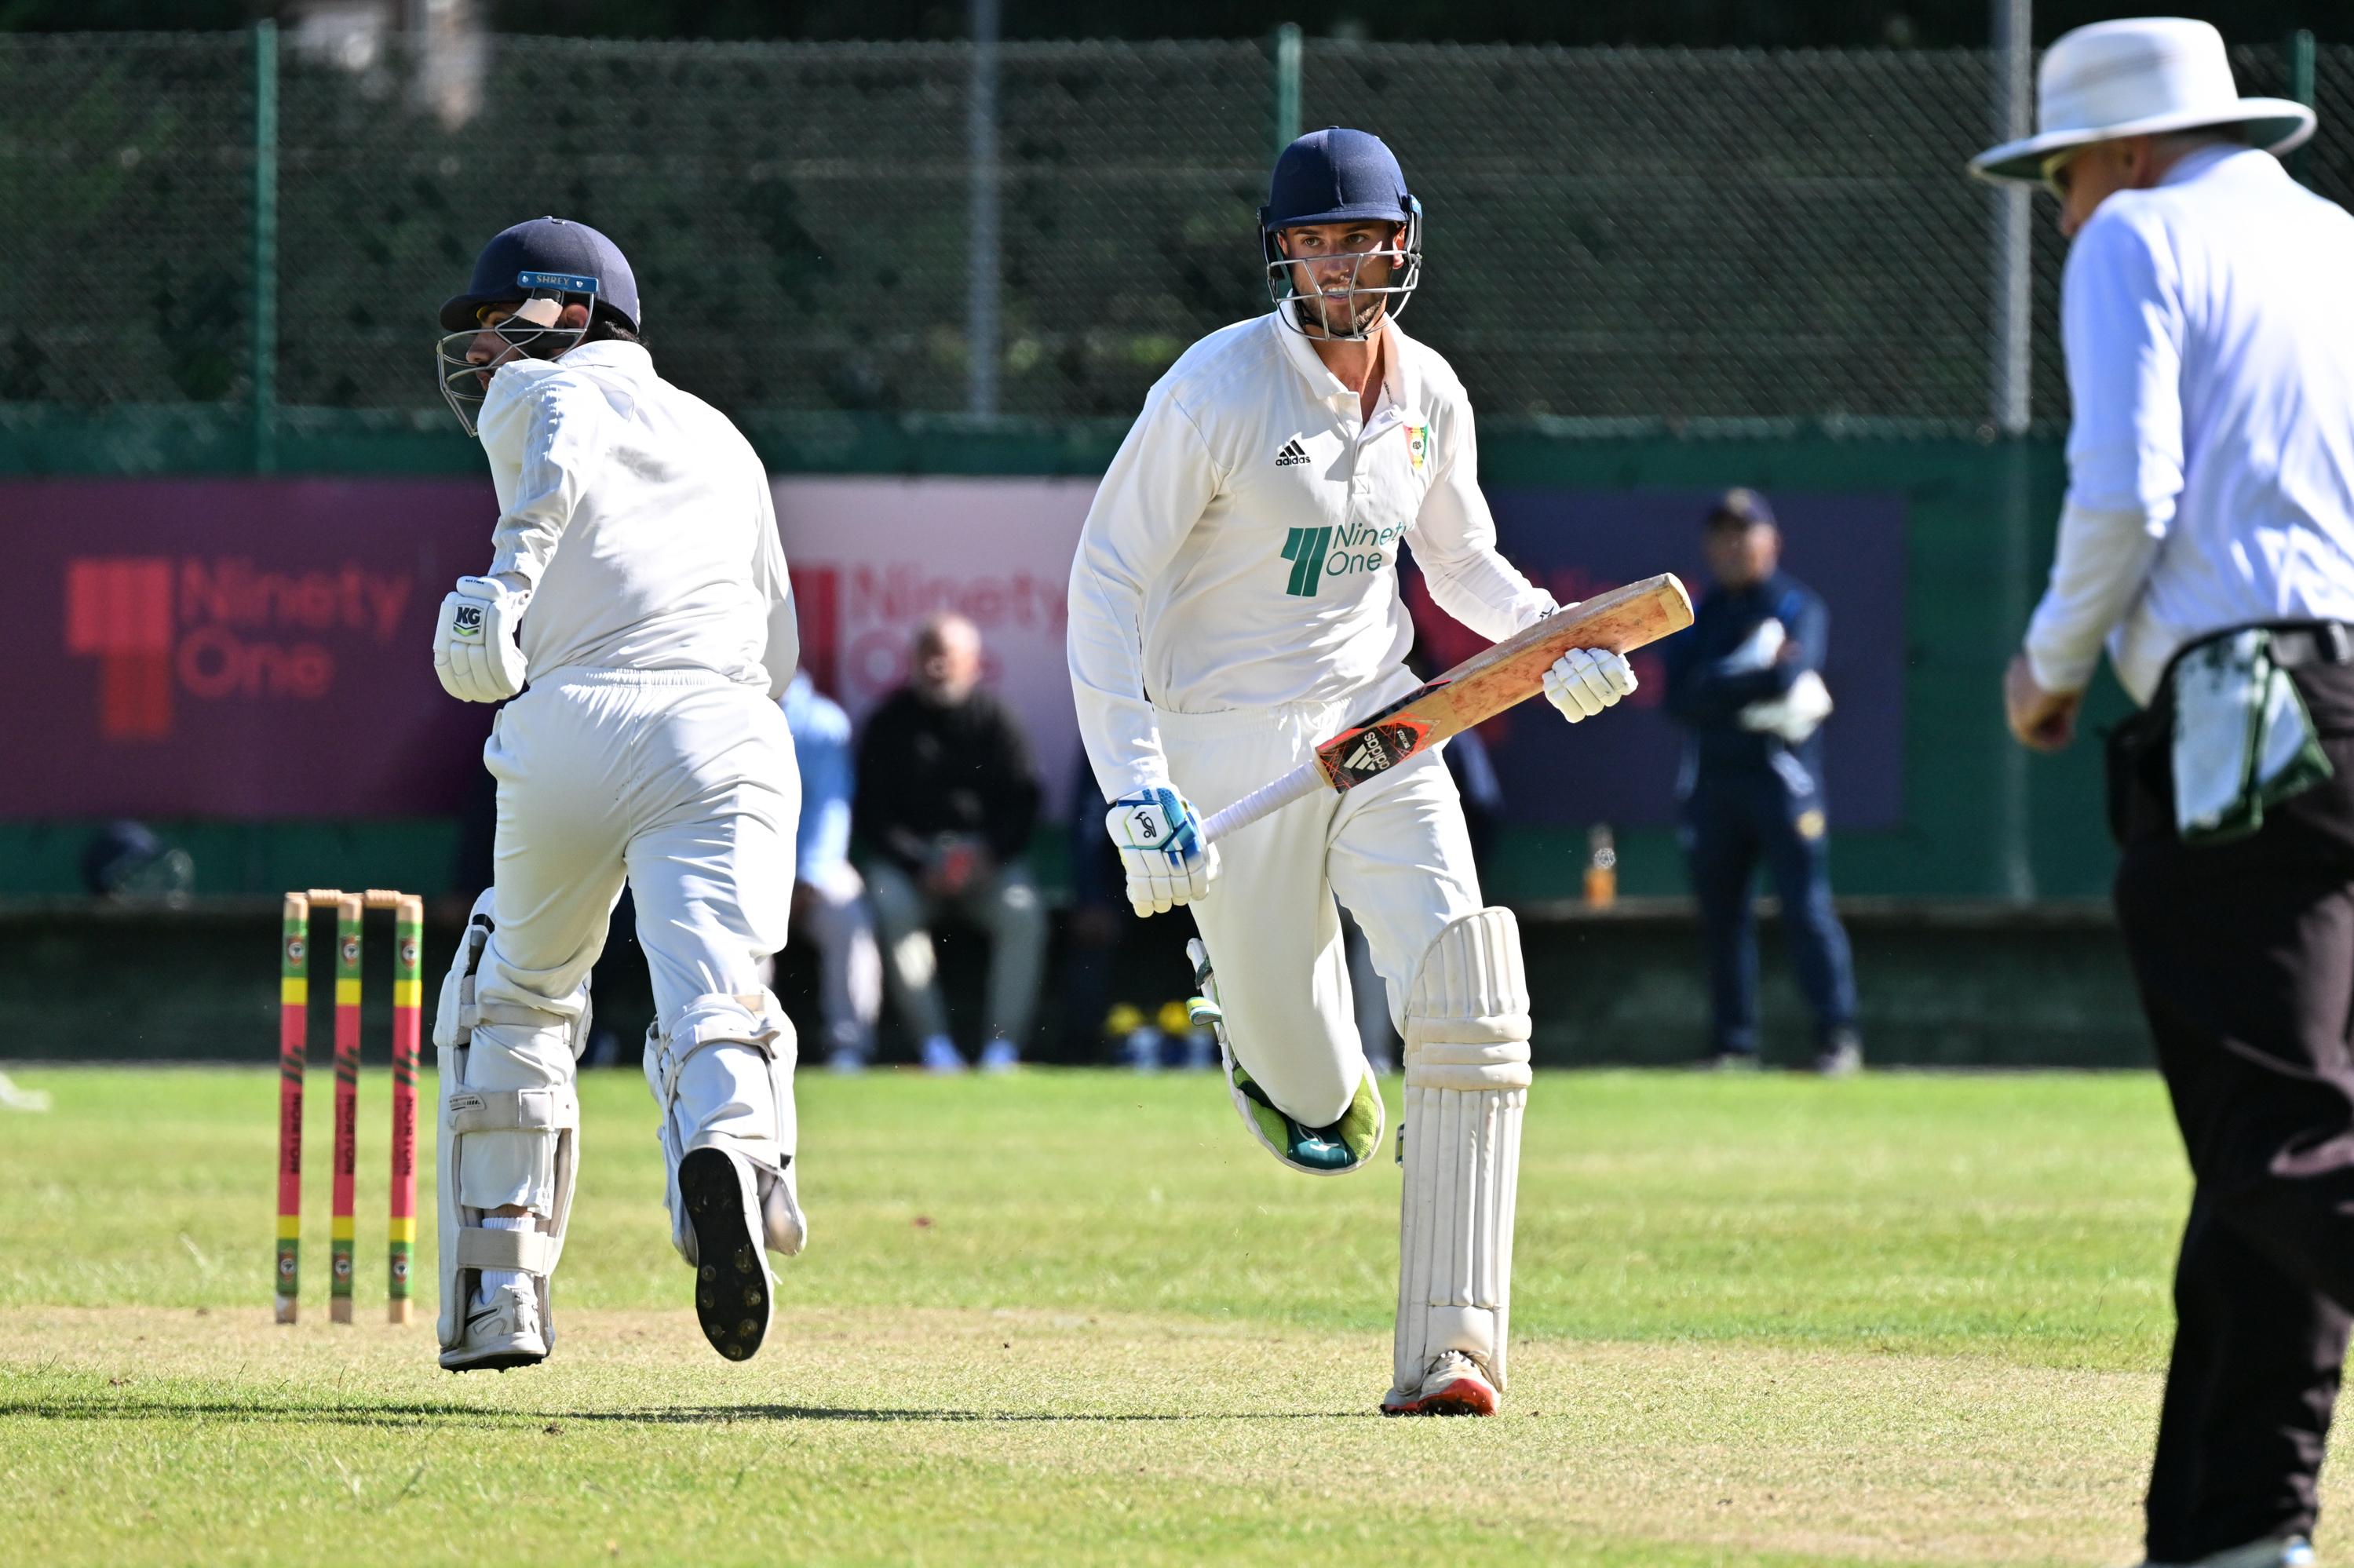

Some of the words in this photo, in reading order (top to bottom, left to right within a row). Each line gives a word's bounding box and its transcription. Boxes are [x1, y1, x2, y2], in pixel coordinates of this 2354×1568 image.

[536, 275, 570, 286] SHREY
[1276, 455, 1311, 466] adidas
[1327, 551, 1382, 576] One
[182, 556, 411, 645] Ninety
[455, 607, 481, 625] KG
[179, 628, 334, 698] One
[1364, 731, 1390, 770] adidas
